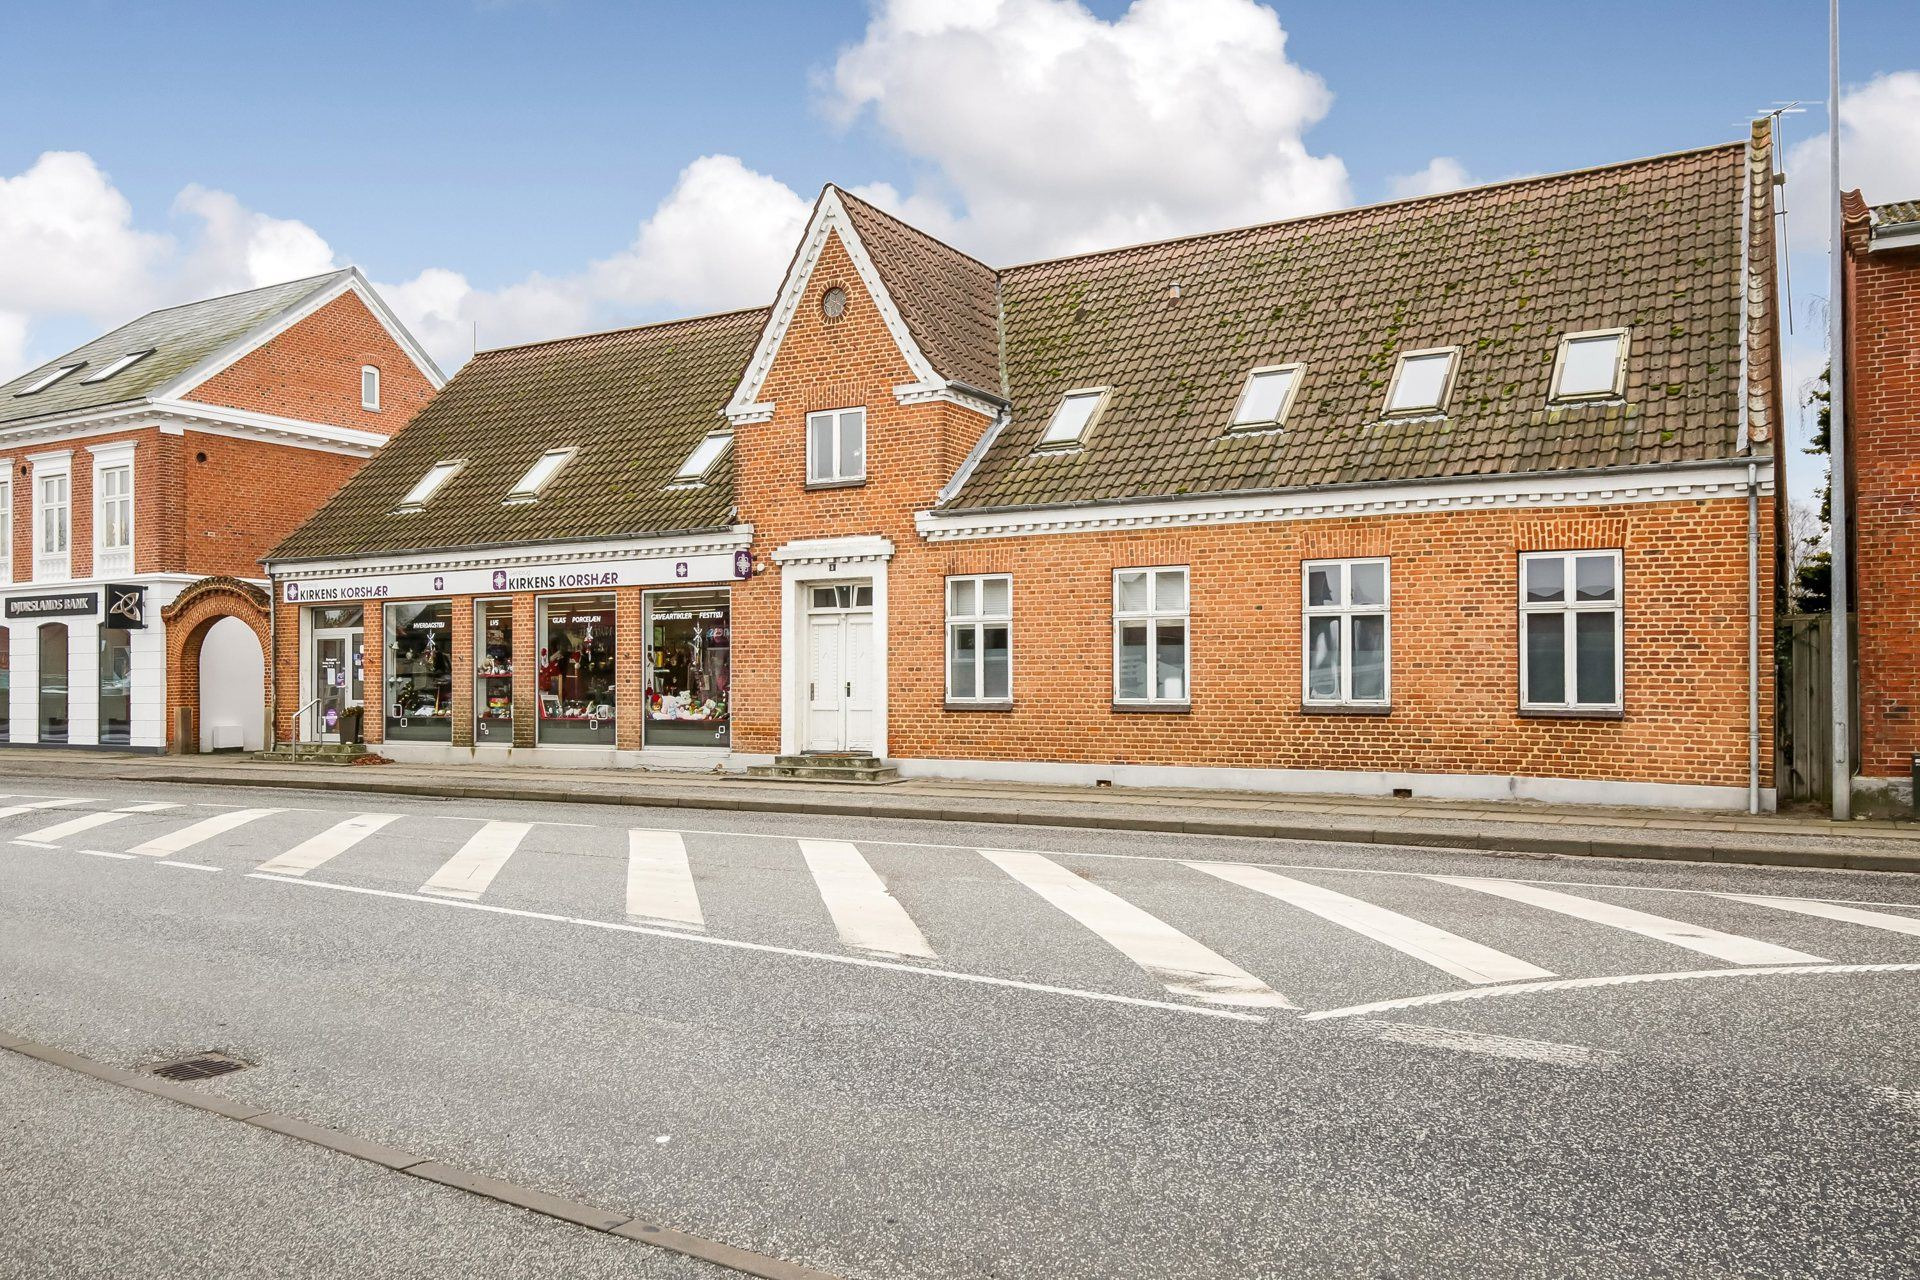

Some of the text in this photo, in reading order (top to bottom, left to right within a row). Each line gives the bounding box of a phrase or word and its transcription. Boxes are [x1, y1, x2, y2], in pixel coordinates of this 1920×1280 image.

[508, 572, 619, 590] KIRKENS KORSHÆR
[300, 585, 388, 601] KIRKENS KORSHÆR
[10, 598, 89, 615] DJURSLANDS BANK
